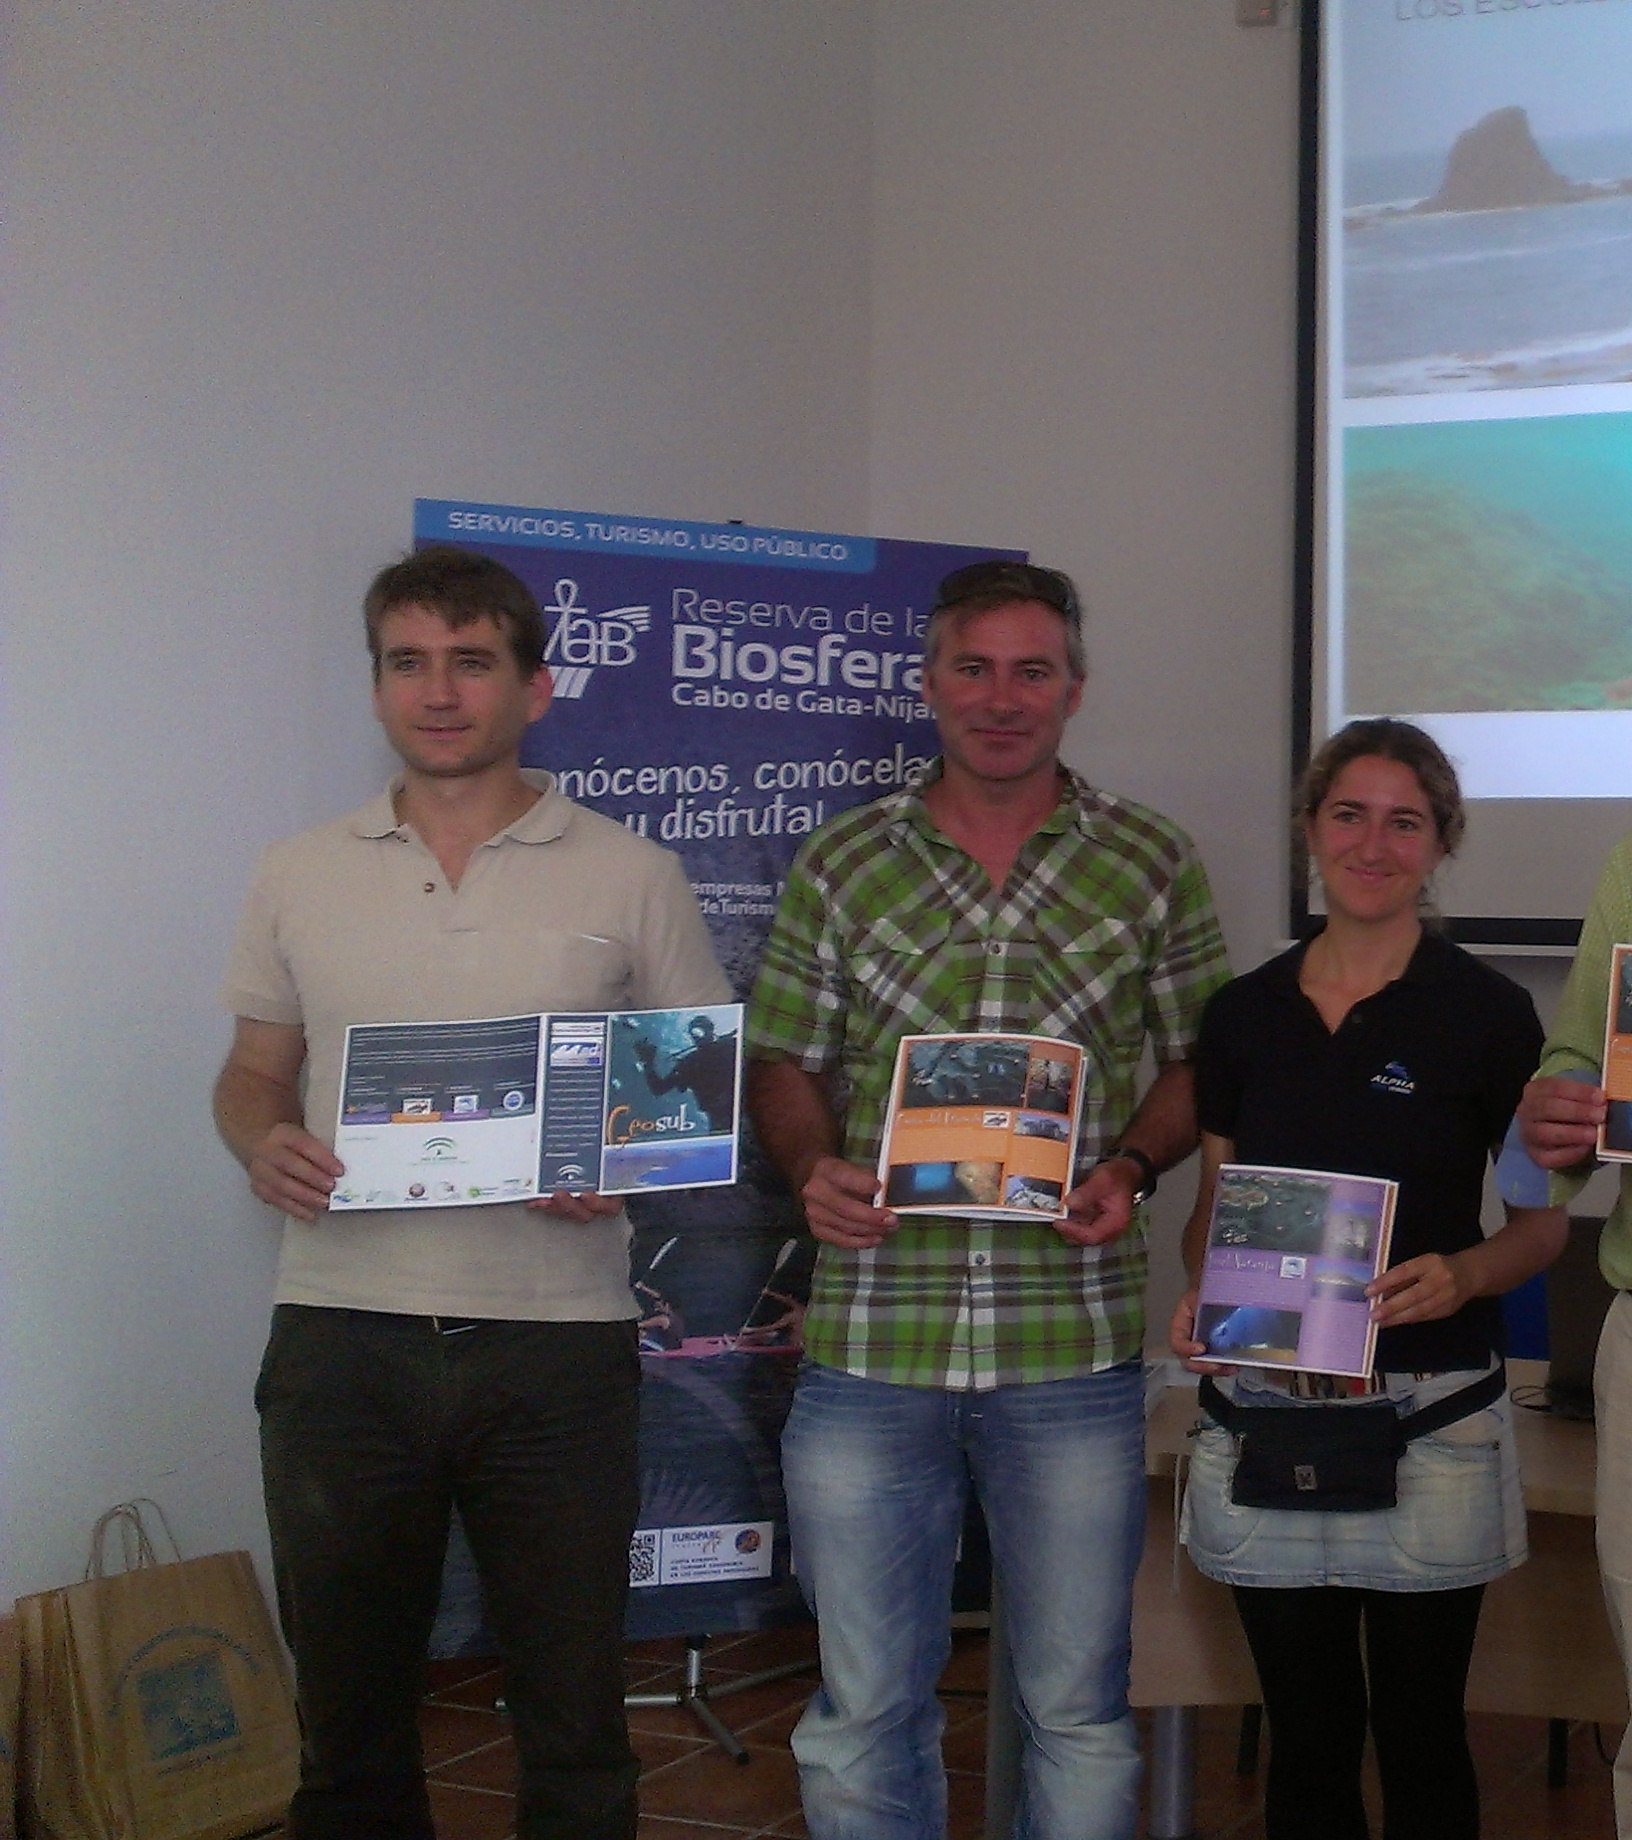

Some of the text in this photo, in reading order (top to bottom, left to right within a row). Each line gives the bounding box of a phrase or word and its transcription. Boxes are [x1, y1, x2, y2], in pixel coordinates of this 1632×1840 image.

[449, 511, 847, 561] SERVICIOS, TURISMO, USO PÚBLICO
[671, 588, 834, 632] Reserva
[844, 603, 893, 636] de
[671, 623, 924, 692] Biosfera
[671, 682, 749, 709] Cabo
[754, 688, 791, 711] de
[555, 757, 741, 799] nócenos,
[690, 882, 772, 898] empresas
[699, 898, 775, 915] de Turism
[1370, 1074, 1416, 1090] ALPHA
